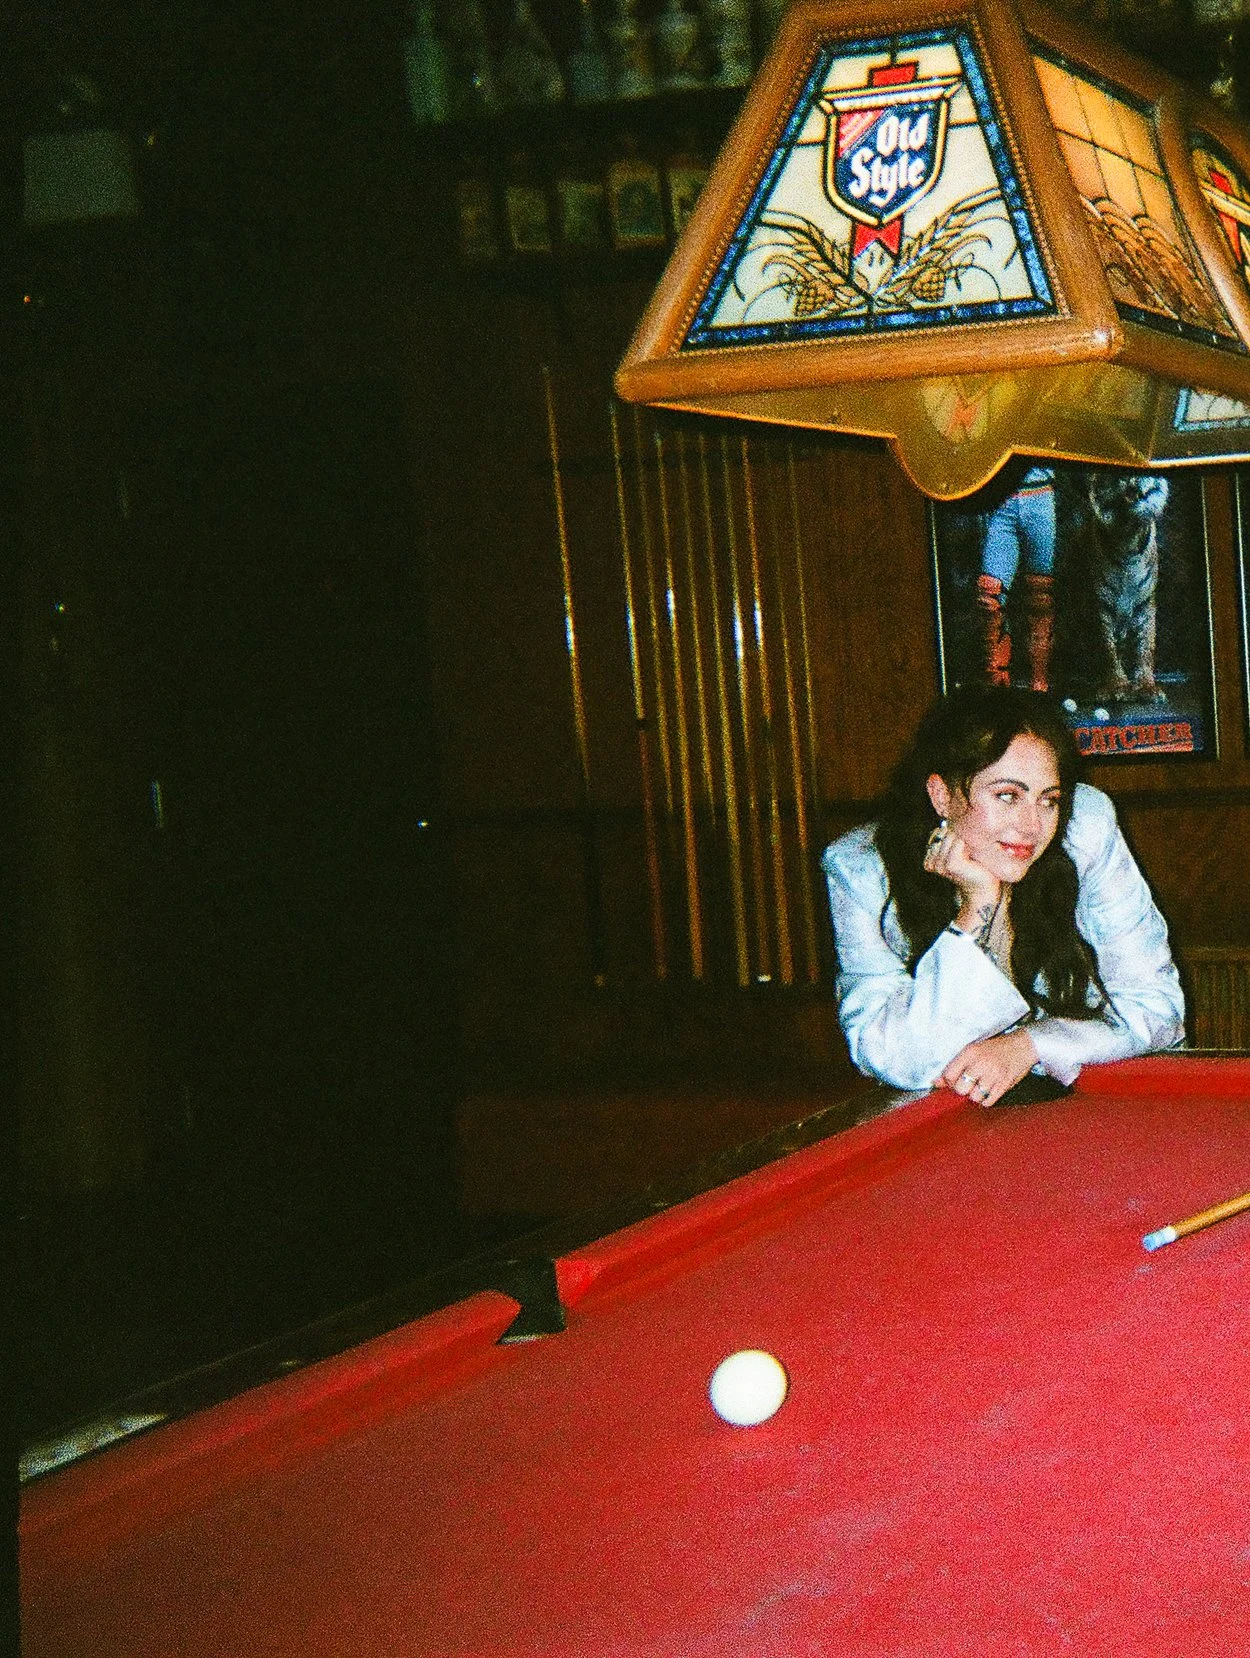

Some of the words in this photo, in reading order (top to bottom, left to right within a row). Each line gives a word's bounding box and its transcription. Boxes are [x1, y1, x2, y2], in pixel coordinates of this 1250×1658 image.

[876, 112, 929, 156] Old
[848, 148, 926, 207] Style
[1074, 721, 1193, 753] CATCHER
